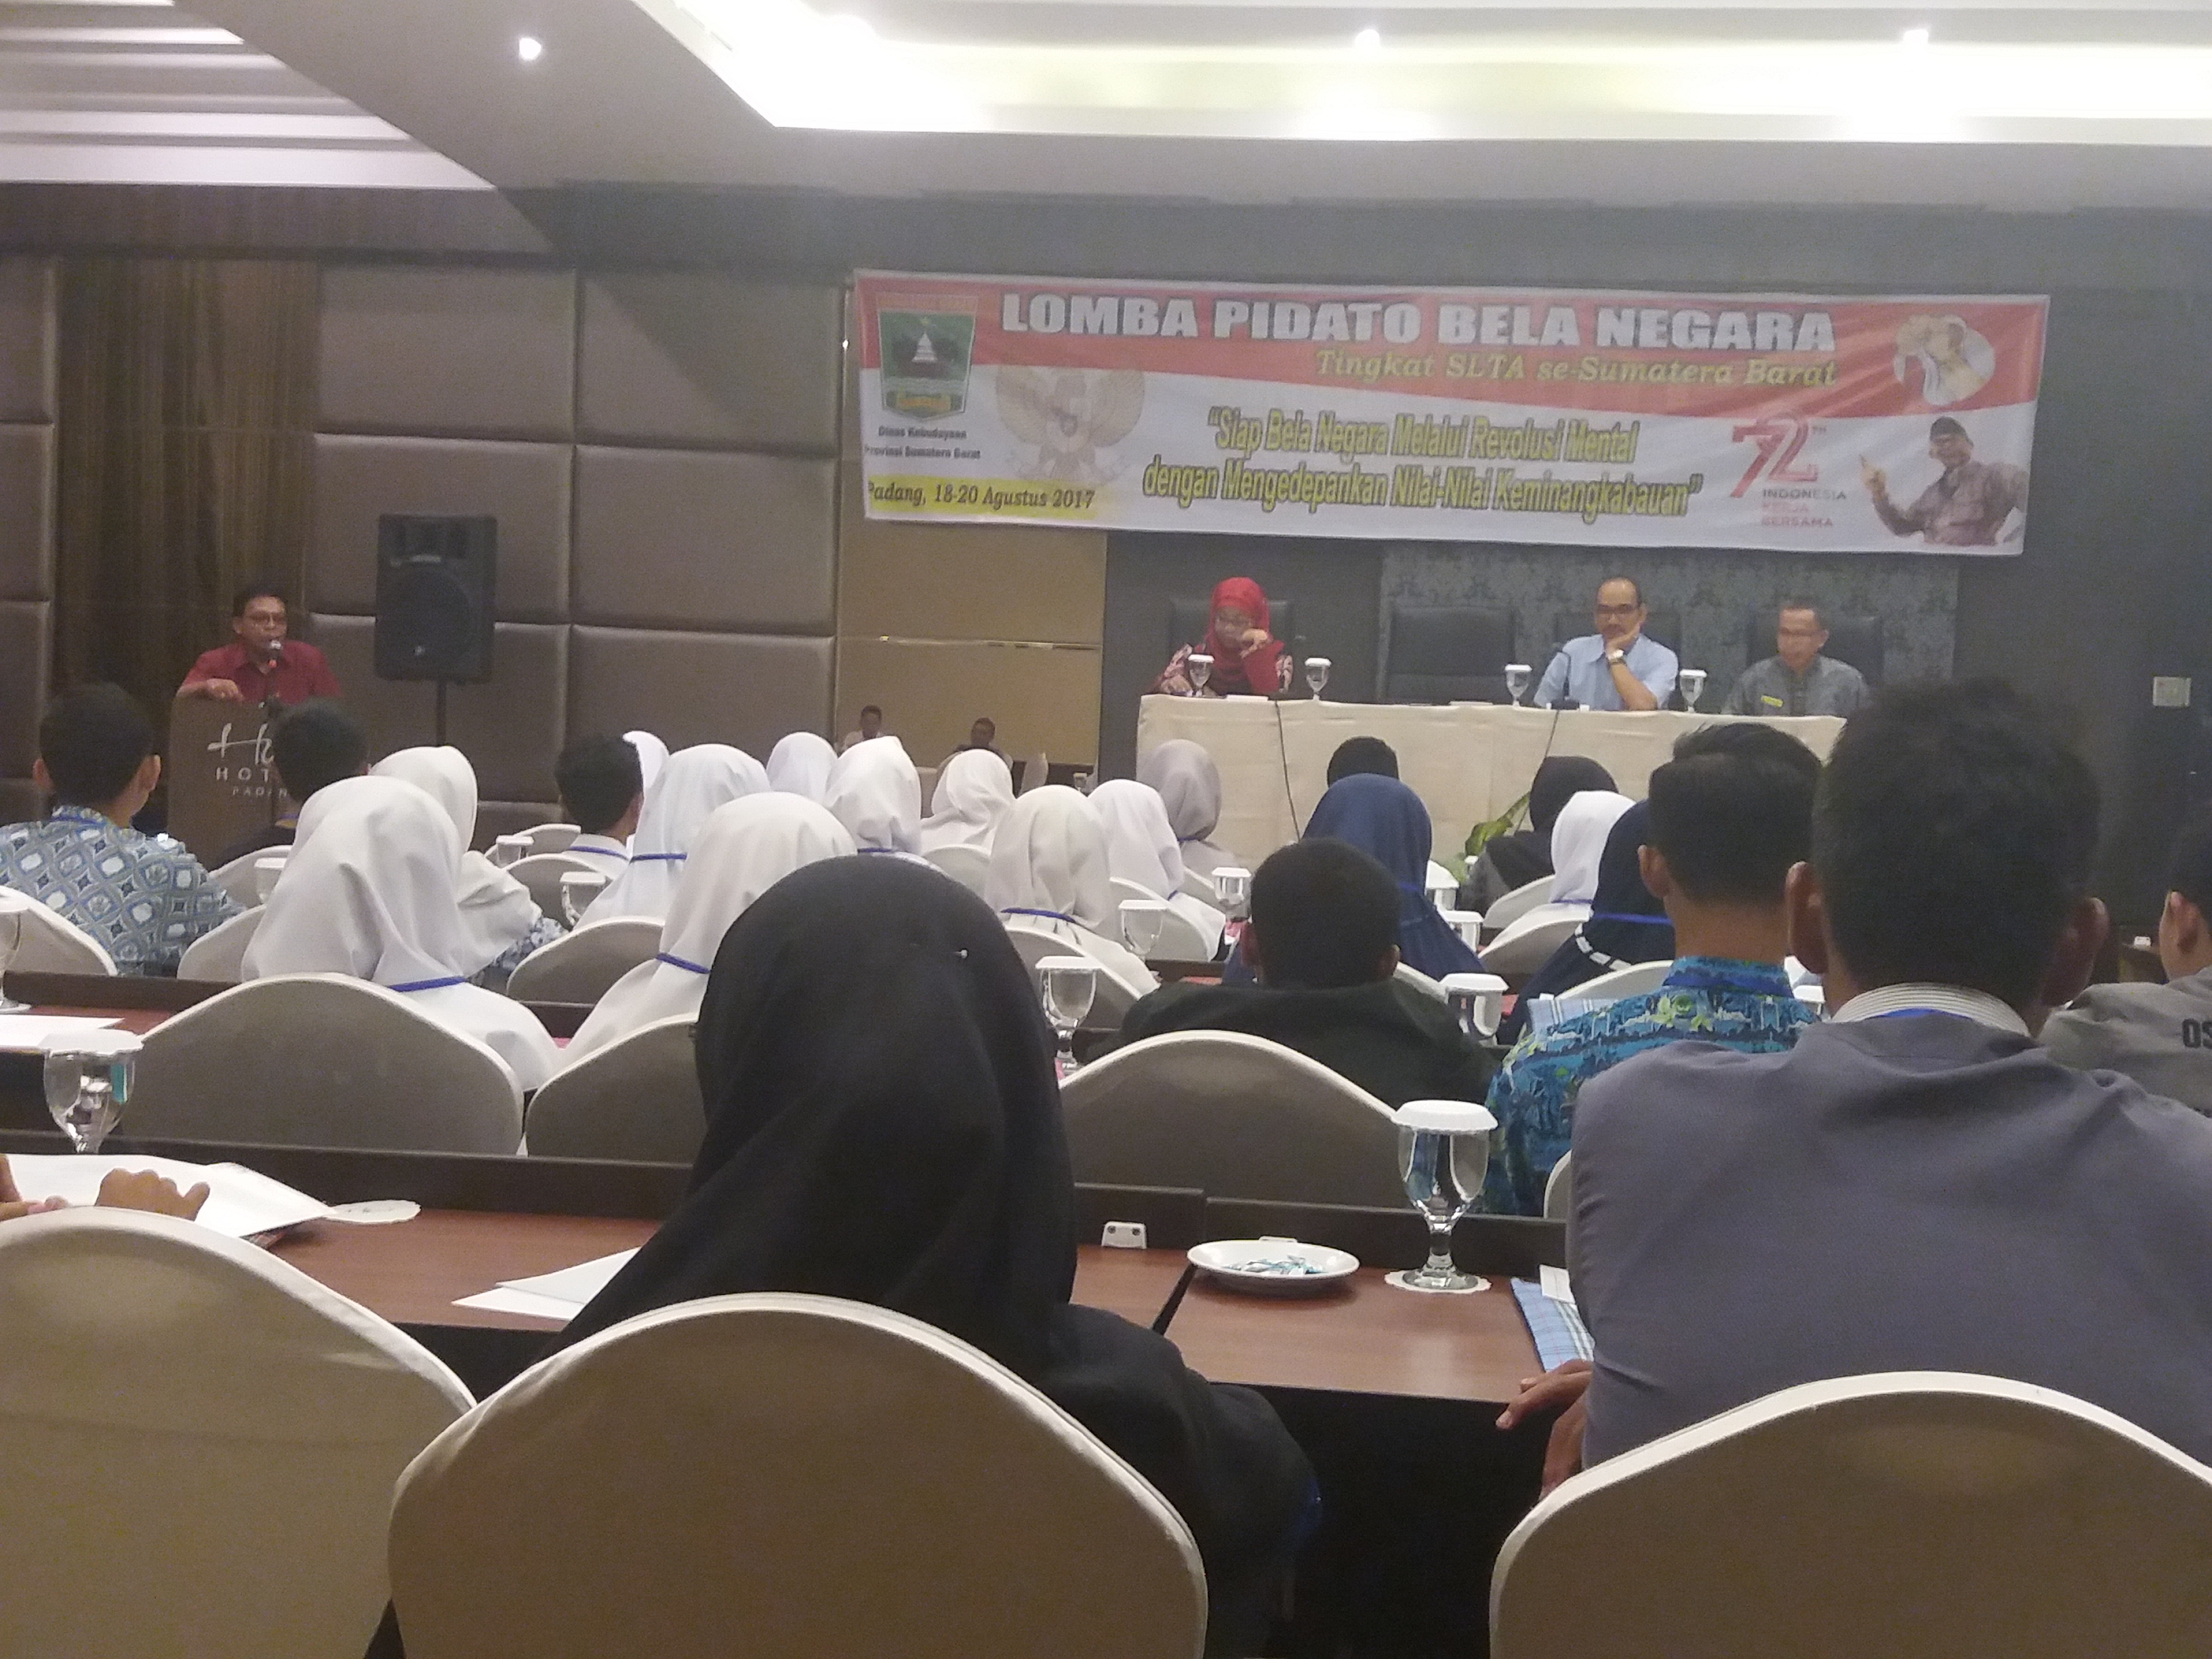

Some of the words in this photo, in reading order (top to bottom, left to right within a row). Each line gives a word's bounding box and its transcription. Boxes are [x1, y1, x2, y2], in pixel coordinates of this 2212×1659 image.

[1002, 293, 1198, 338] LOMBA
[1214, 299, 1421, 344] PIDATO
[1438, 304, 1580, 346] BELA
[1596, 308, 1835, 351] NEGARA
[1317, 349, 1435, 384] Tingkat
[1446, 354, 1525, 380] SLTA
[1537, 356, 1734, 386] se-Sumatera
[1744, 358, 1837, 388] Barat
[1264, 408, 1312, 452] Bela
[1314, 411, 1389, 464] Negara
[1391, 413, 1469, 457] Melalui
[1469, 415, 1565, 462] Revolusi
[1563, 419, 1640, 464] Mental
[1730, 412, 1818, 498] 72
[935, 483, 979, 504] 18-20
[983, 486, 1048, 511] Agustus
[1053, 489, 1096, 510] 2017
[1143, 454, 1220, 509] dengan
[1221, 457, 1389, 514] Mengedepankan
[1389, 464, 1494, 510] Nilai-Nilai
[1763, 489, 1847, 499] INDONESIA
[216, 766, 269, 783] HOT
